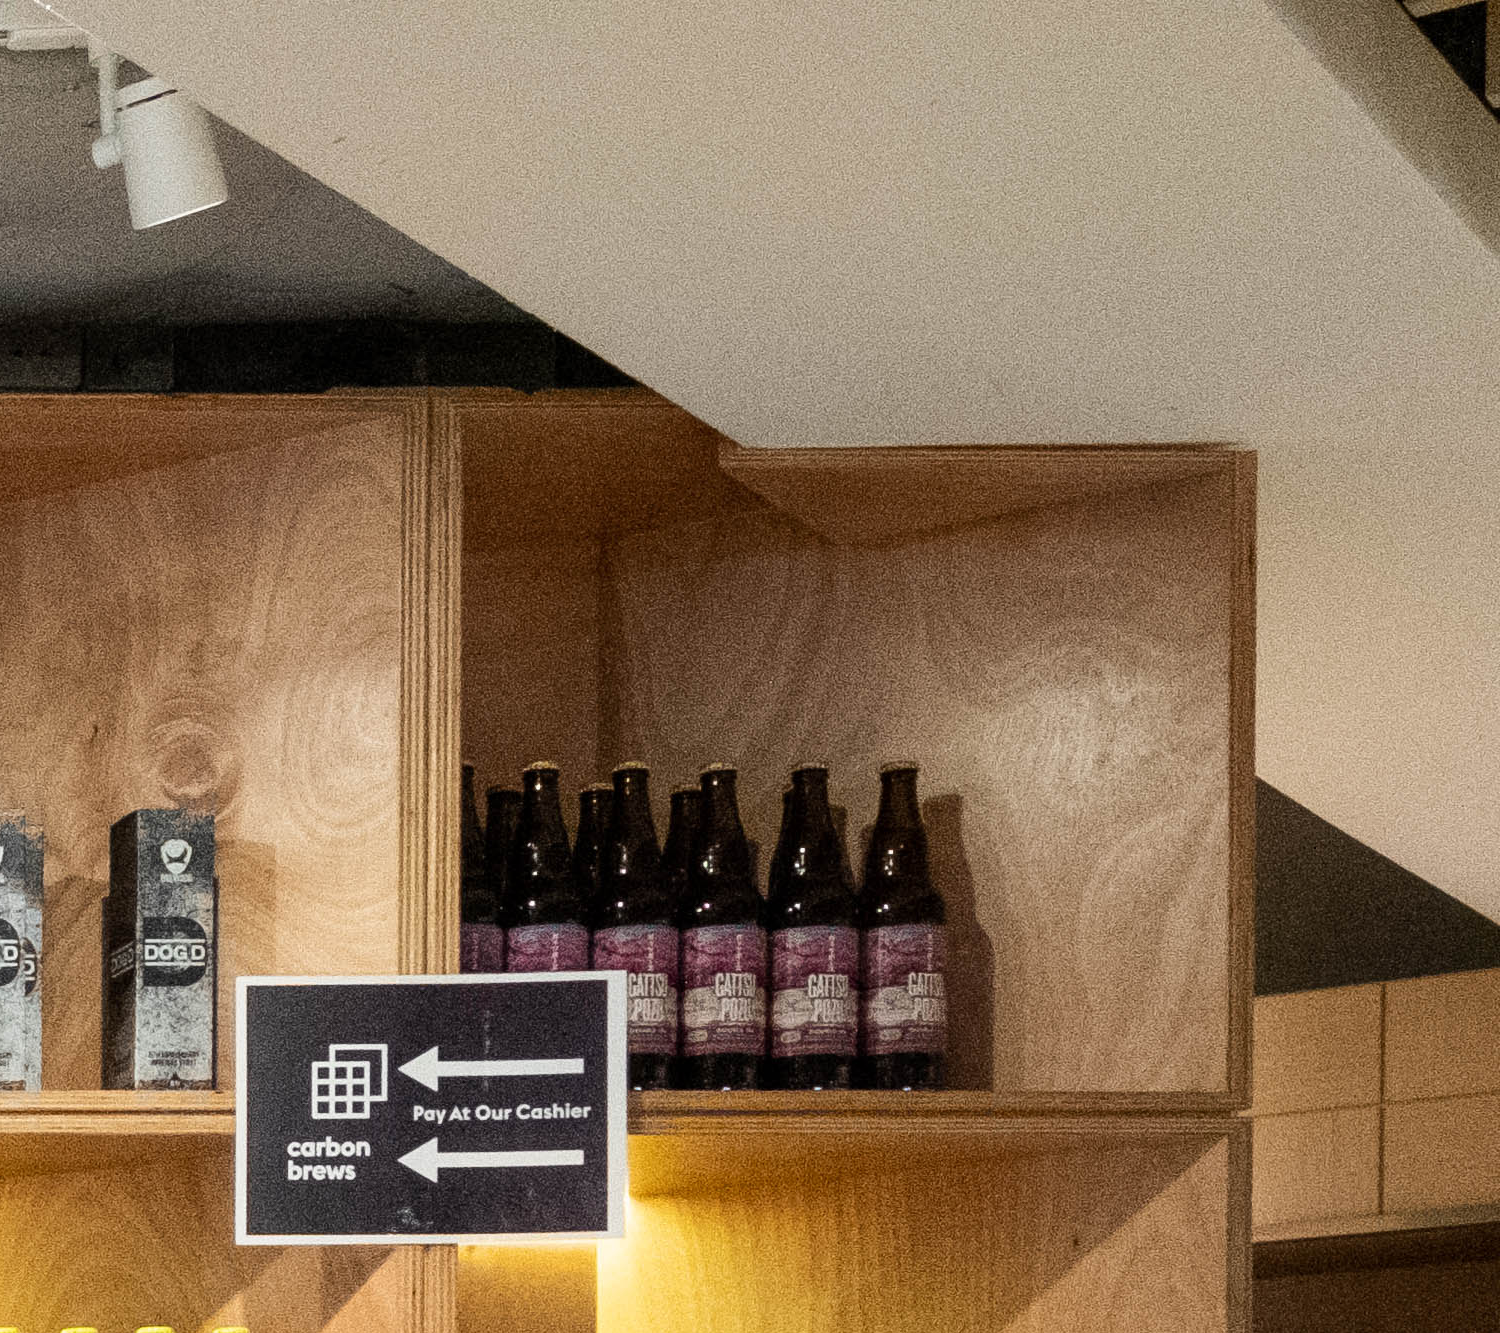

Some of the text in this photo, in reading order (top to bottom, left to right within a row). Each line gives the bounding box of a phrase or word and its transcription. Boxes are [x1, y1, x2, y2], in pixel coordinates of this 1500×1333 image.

[413, 1102, 591, 1125] Pay At Our Cashier
[287, 1138, 370, 1159] carbon
[287, 1160, 356, 1181] brews
